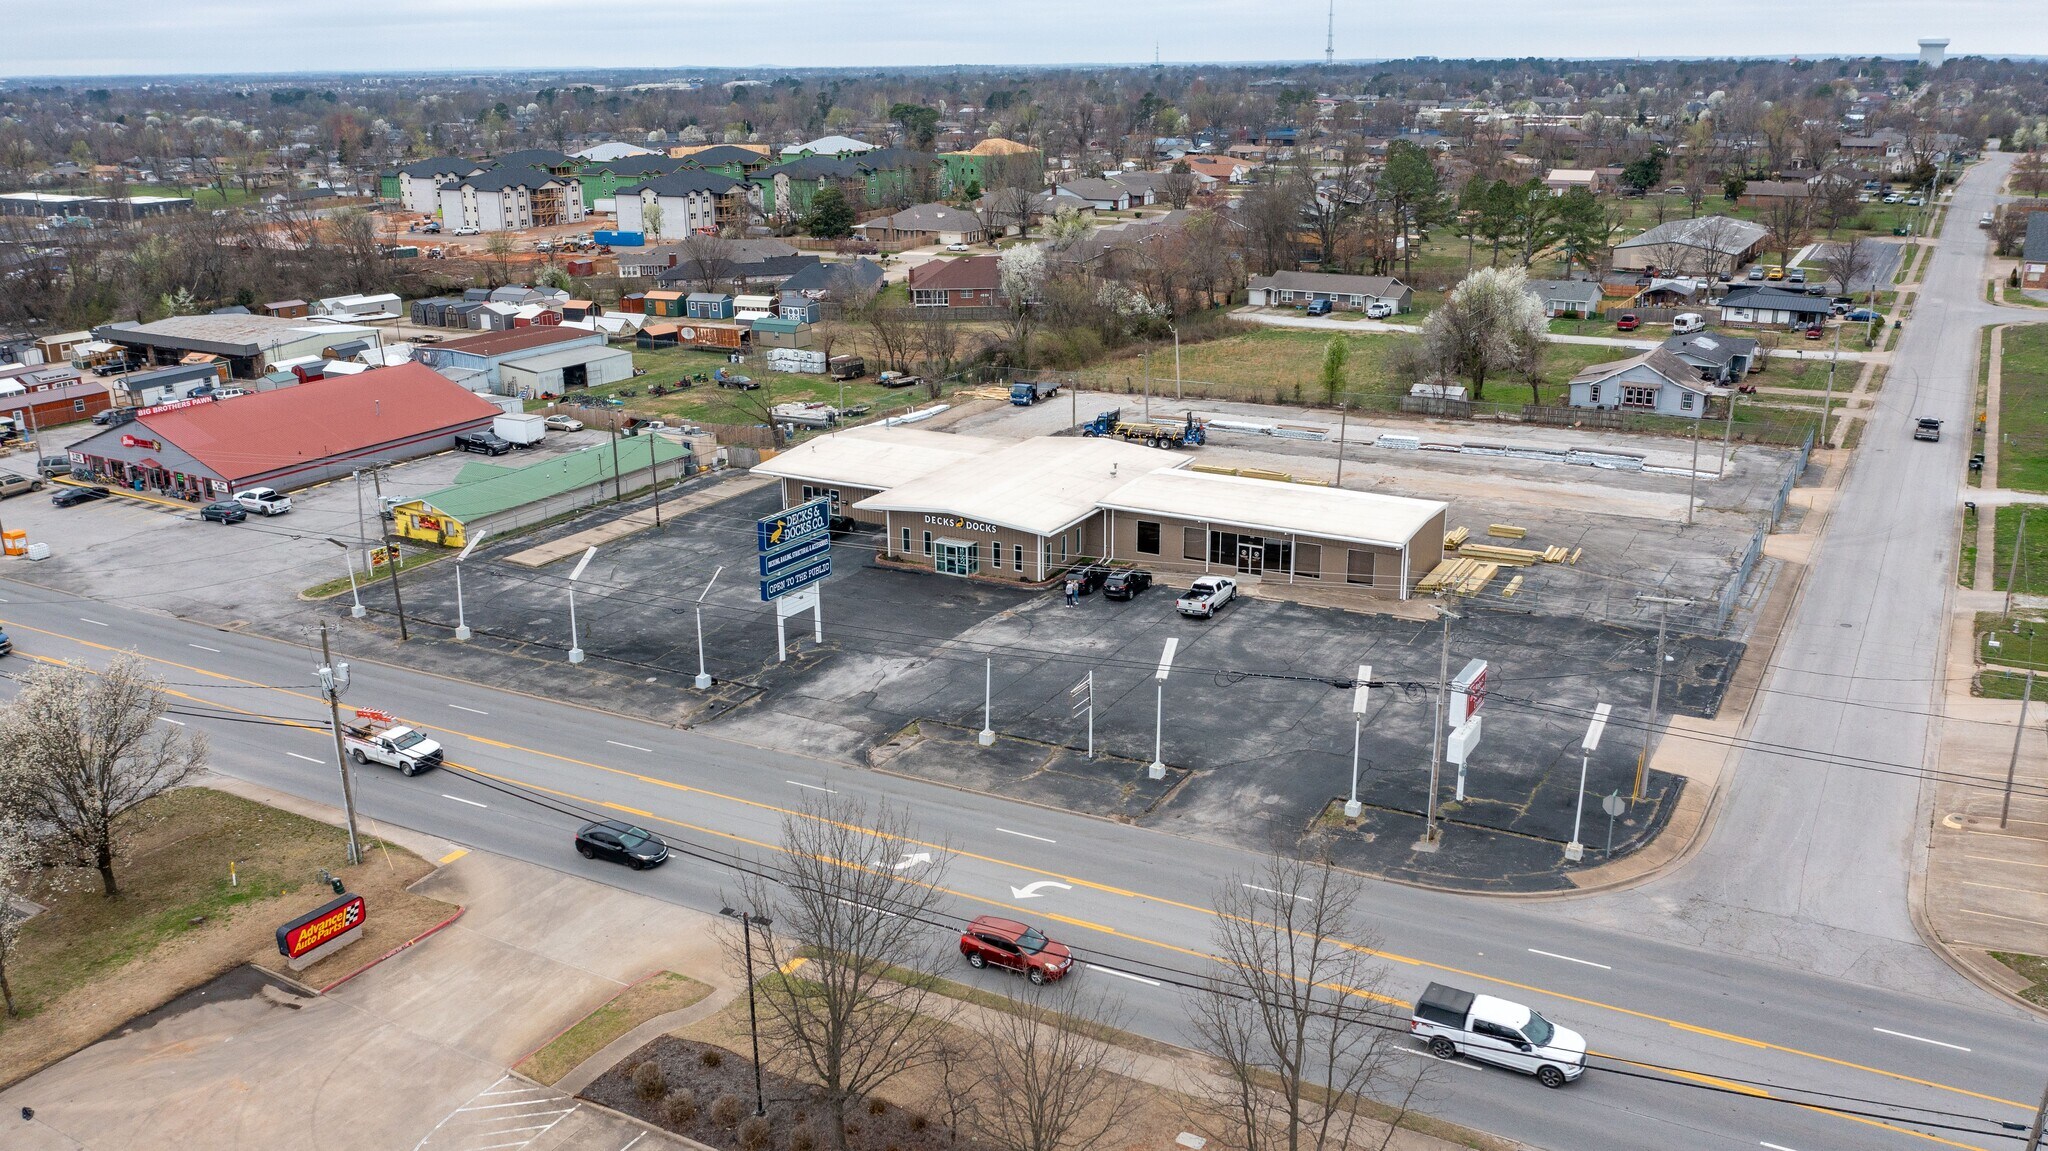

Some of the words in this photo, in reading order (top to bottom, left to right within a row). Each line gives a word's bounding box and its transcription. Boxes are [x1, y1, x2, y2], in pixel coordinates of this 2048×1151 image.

[137, 408, 152, 416] BIG
[153, 400, 191, 413] BROTHERS
[192, 396, 213, 406] PAWN
[784, 521, 812, 540] DOCKS
[812, 516, 825, 529] CO.
[786, 508, 813, 527] DECKS
[813, 505, 820, 517] &
[925, 515, 954, 527] DECKS
[966, 521, 996, 533] DOCKS
[769, 580, 786, 594] OPEN
[786, 577, 795, 587] TO
[795, 571, 808, 583] THE
[808, 563, 829, 577] PUBLIC
[293, 936, 317, 954] Auto
[316, 921, 342, 941] Parts
[299, 912, 343, 942] Advance
